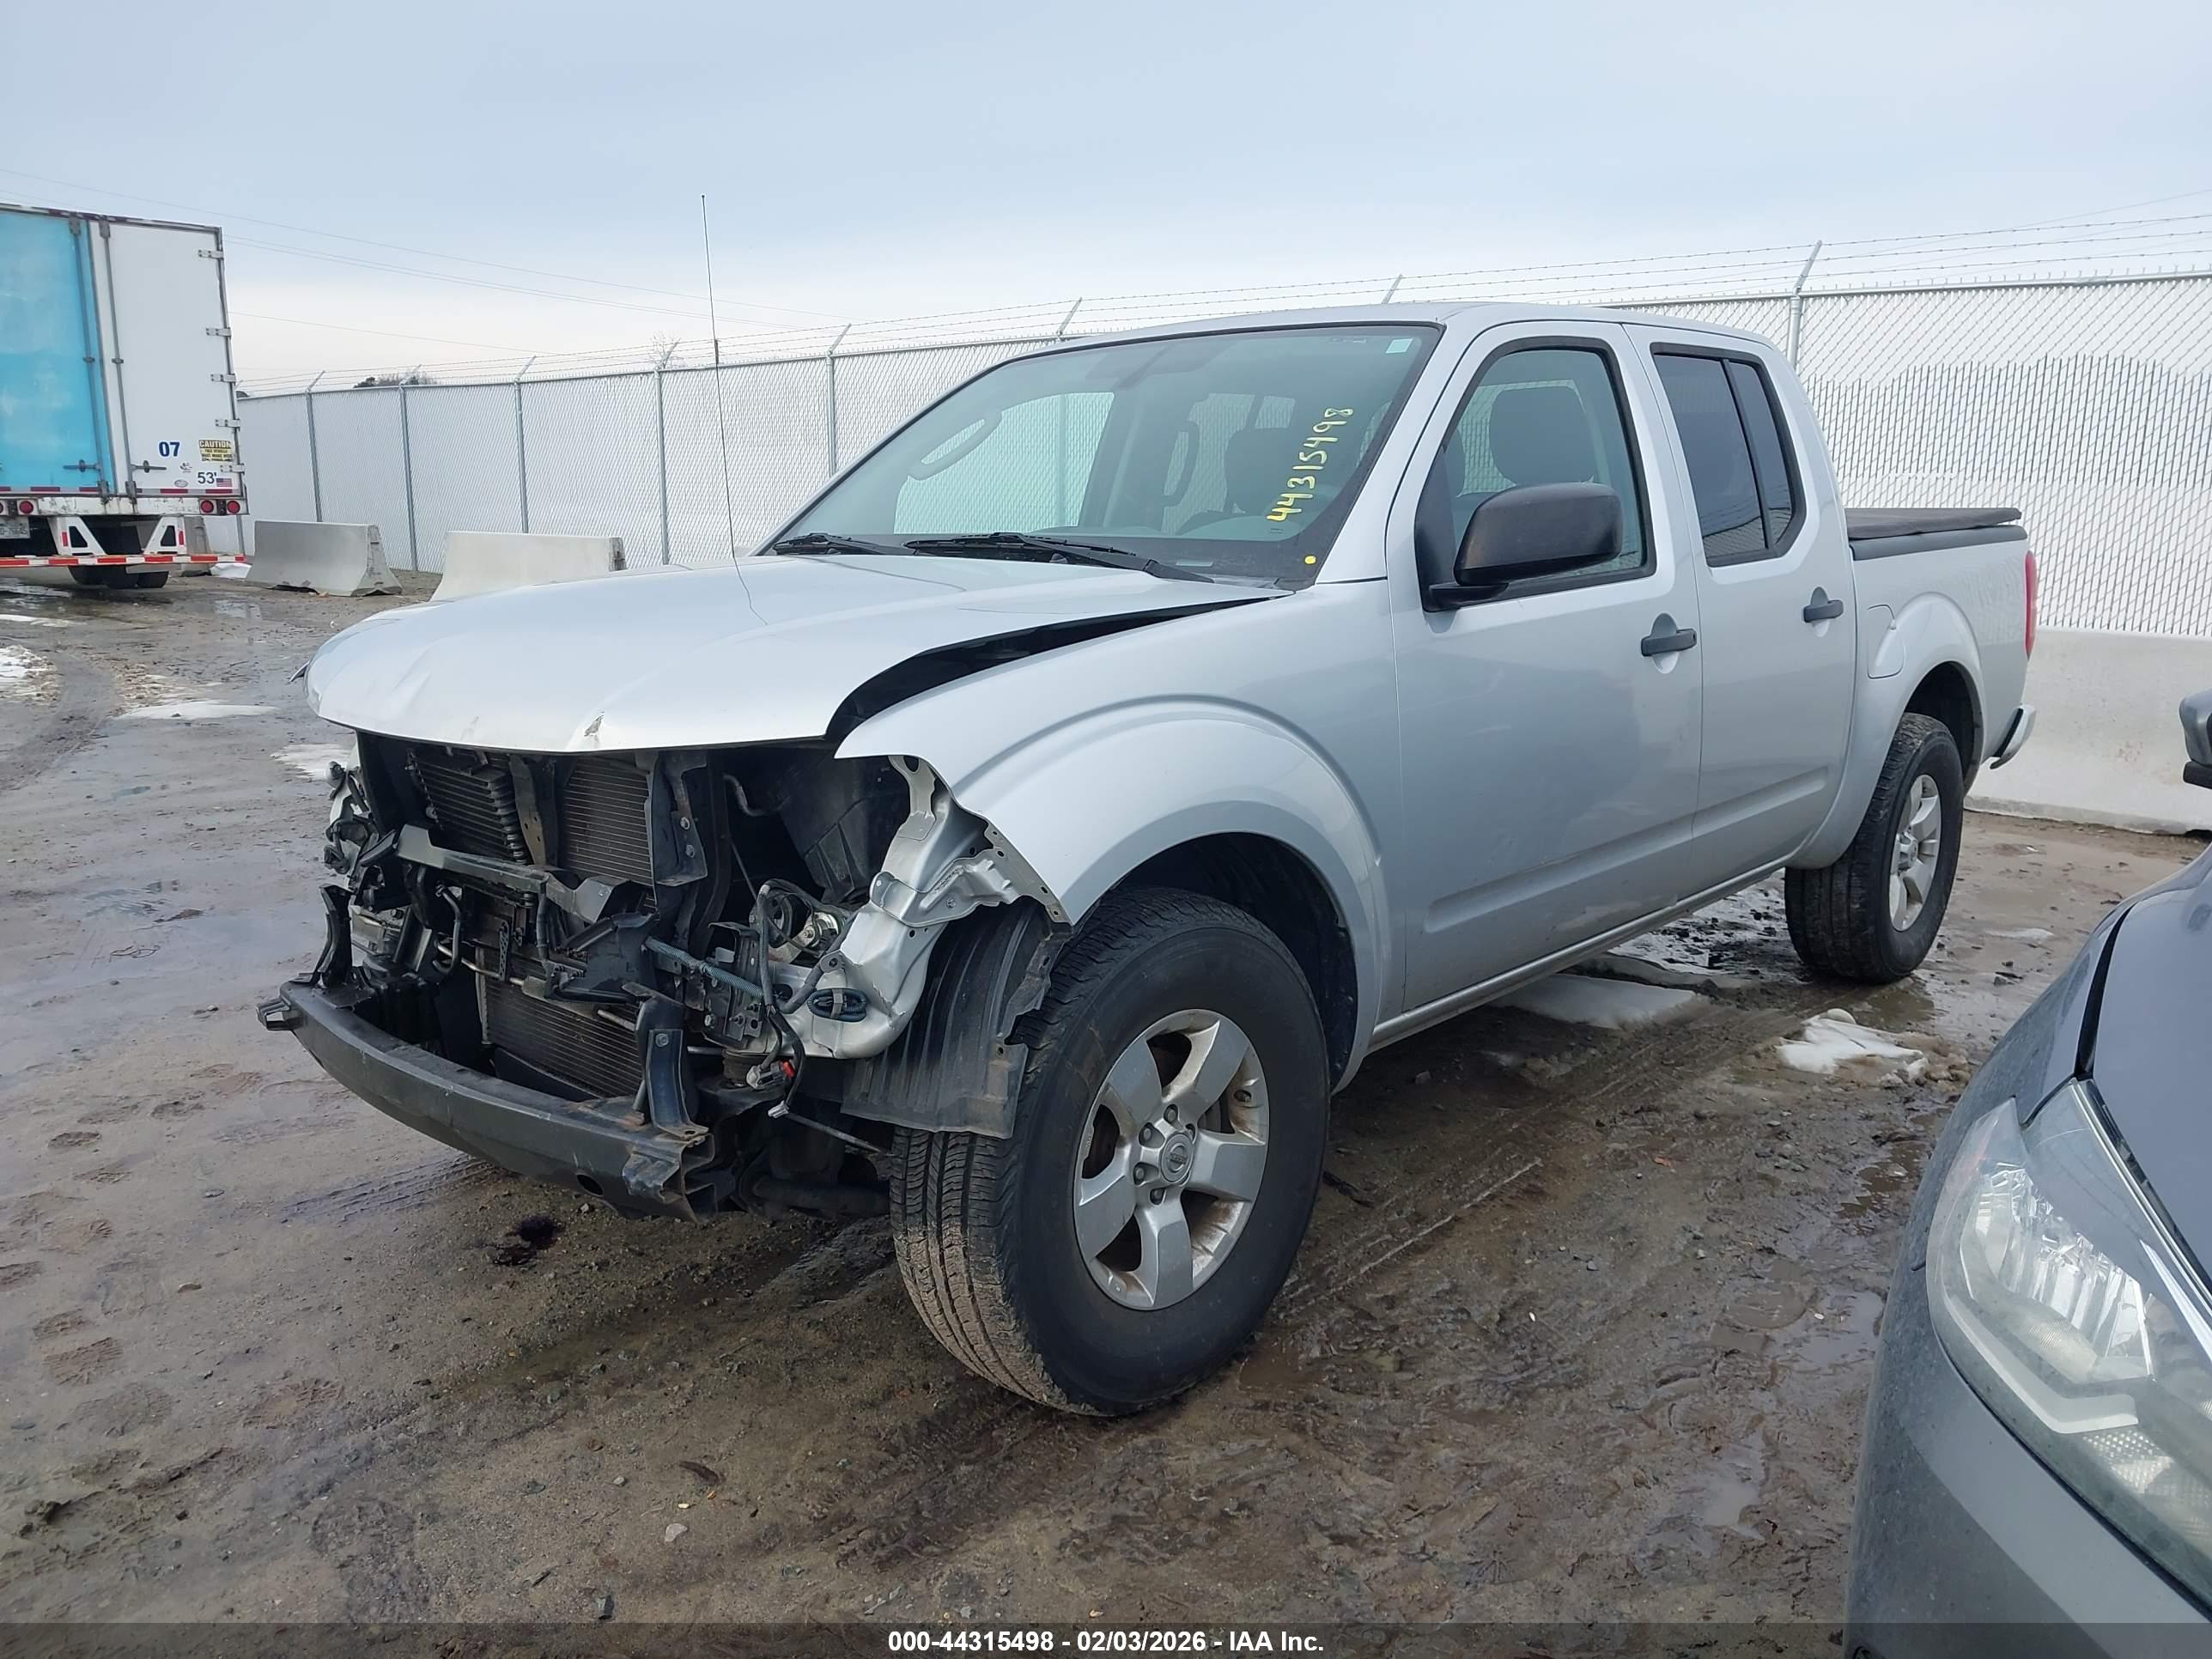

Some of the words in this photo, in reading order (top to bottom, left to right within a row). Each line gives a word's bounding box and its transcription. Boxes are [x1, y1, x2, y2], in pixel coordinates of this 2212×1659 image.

[159, 441, 179, 457] 07
[199, 440, 231, 448] CAUTION
[1267, 408, 1353, 521] 44315498
